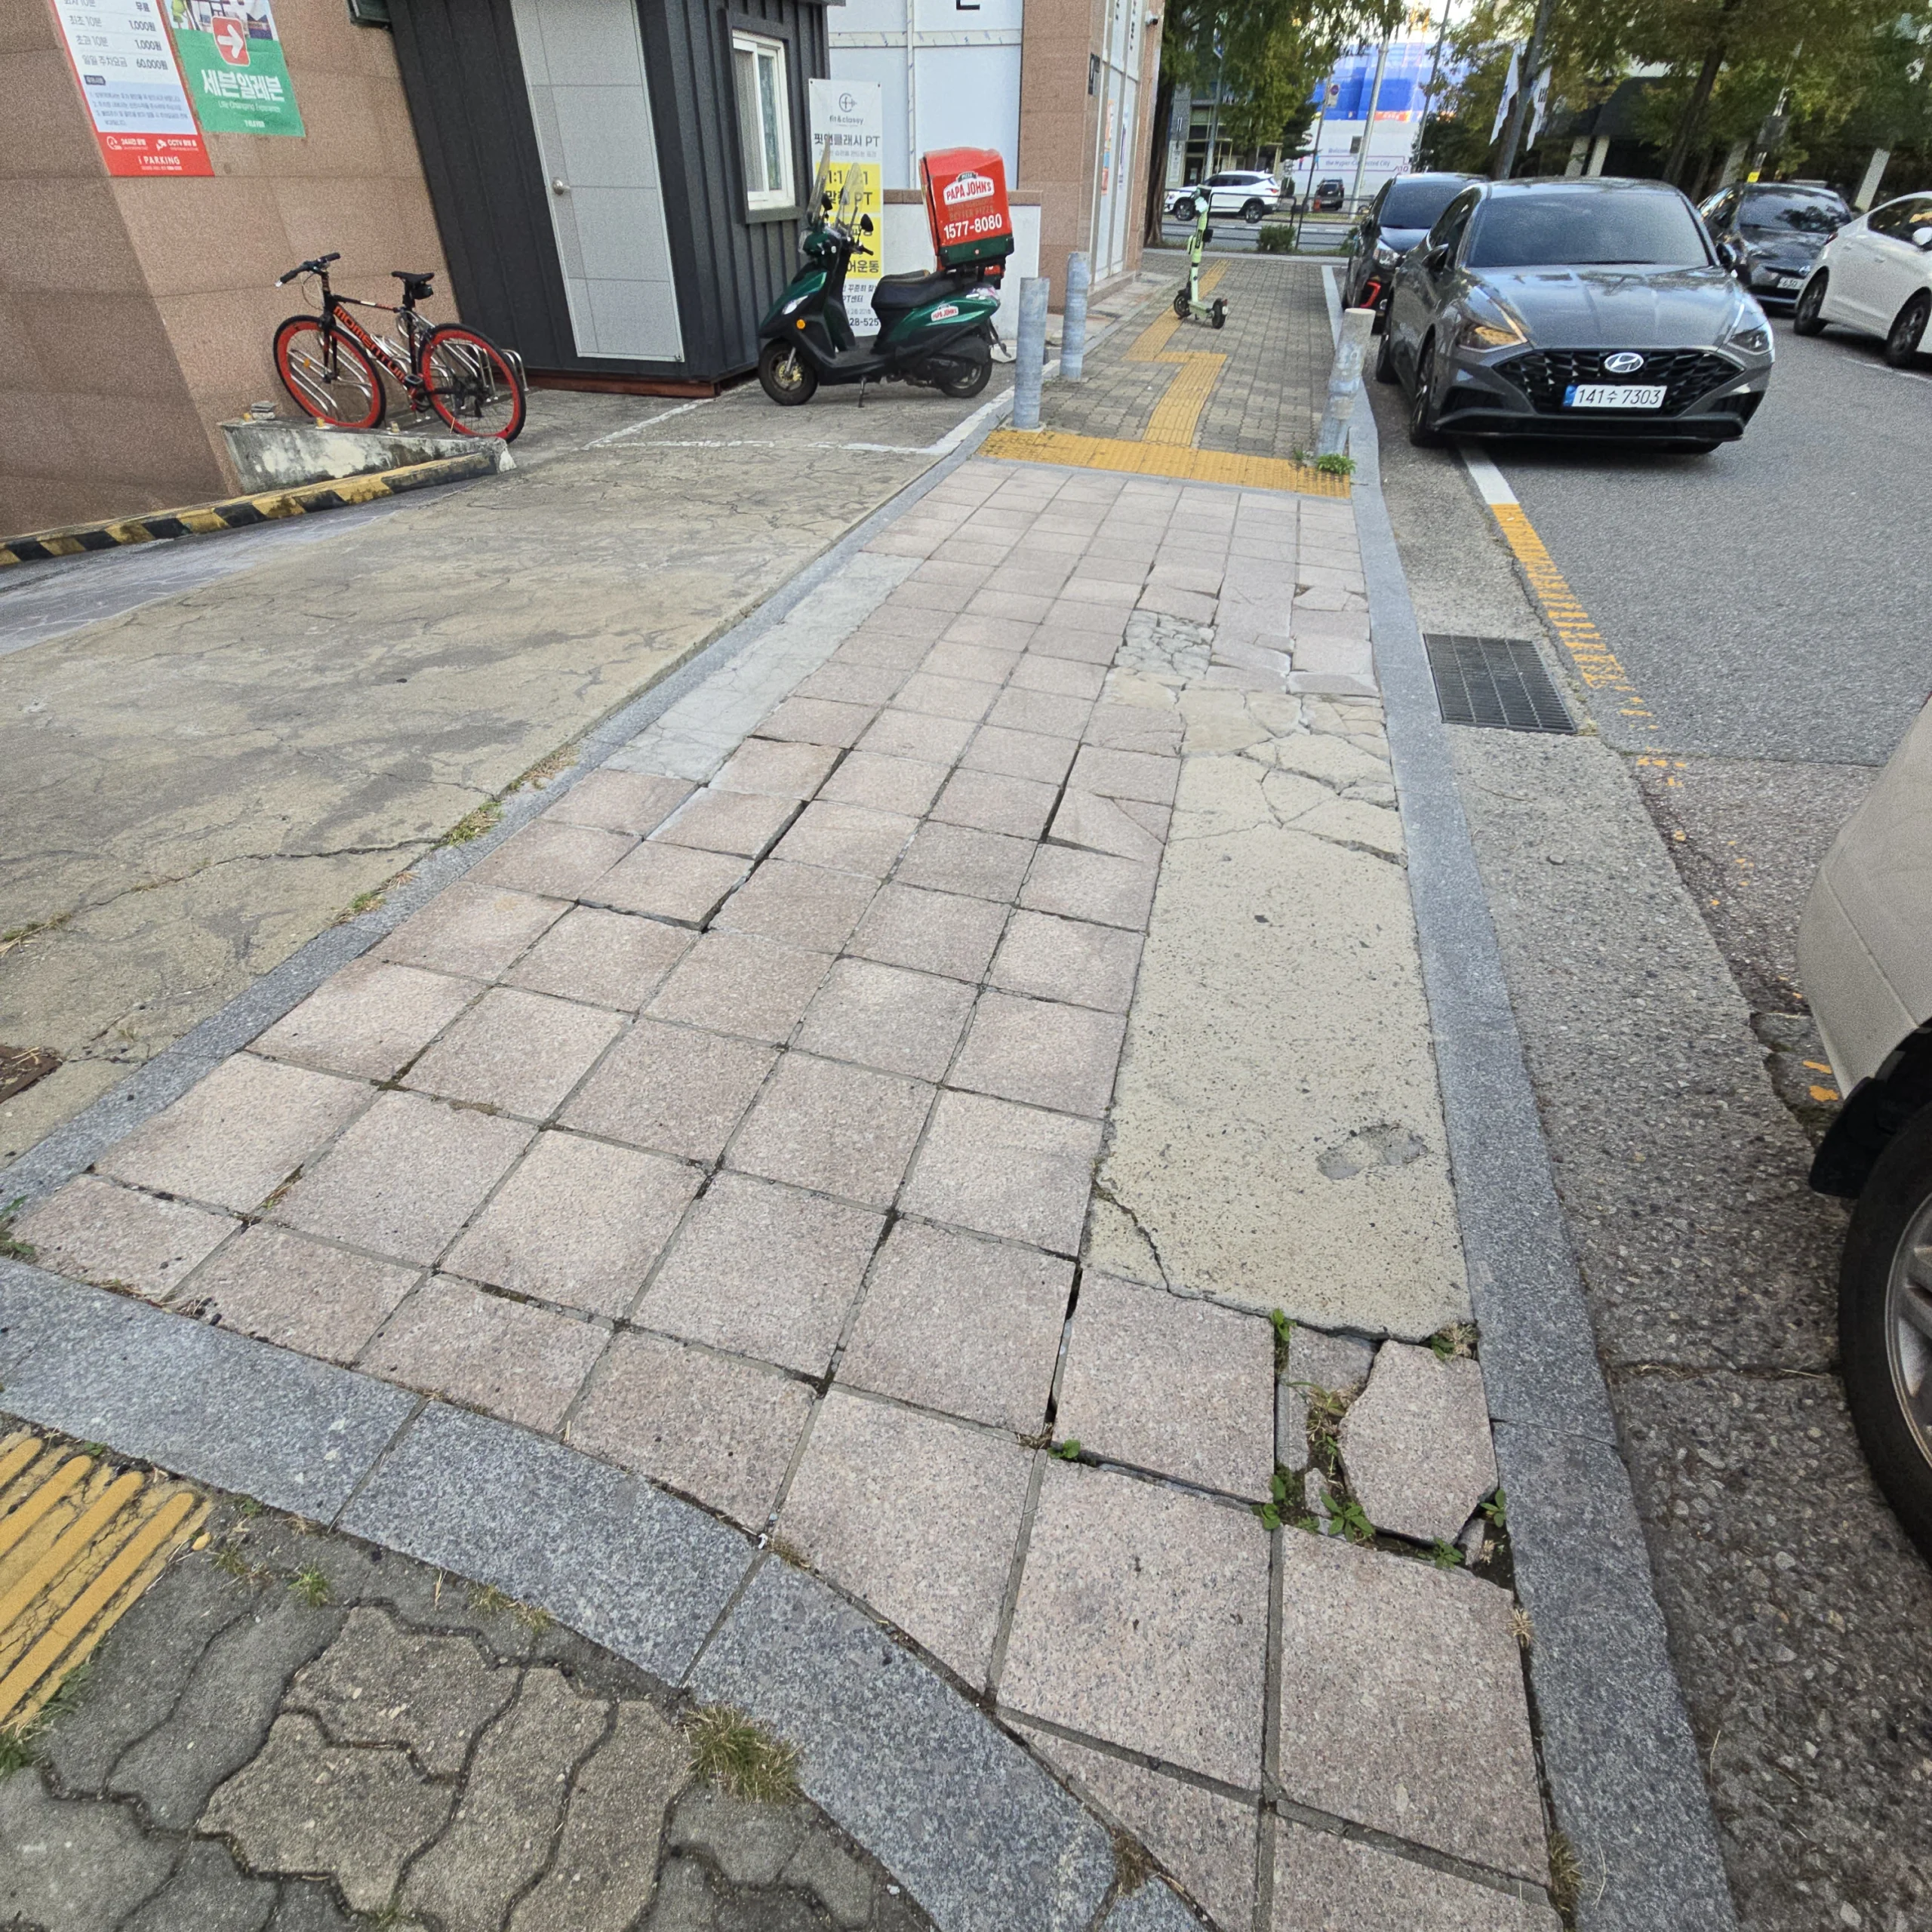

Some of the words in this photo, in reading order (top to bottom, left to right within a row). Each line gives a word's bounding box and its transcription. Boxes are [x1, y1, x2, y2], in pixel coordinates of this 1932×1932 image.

[135, 2, 151, 12] 무료
[69, 15, 85, 26] 최초
[85, 17, 103, 27] 10분
[128, 20, 156, 32] 1,000원
[76, 35, 91, 45] 초과
[92, 35, 109, 47] 10분
[99, 55, 128, 67] 주차요금
[136, 58, 168, 70] 60,000원
[201, 69, 285, 103] 세븐일레븐
[866, 135, 881, 147] PT
[143, 156, 180, 165] PARKING
[946, 184, 966, 201] PAPA
[966, 181, 992, 196] JOHN'S
[943, 213, 1002, 239] 1577-8080
[334, 306, 406, 382] MOMENTUM
[1579, 388, 1617, 404] 141수
[1622, 389, 1662, 405] 7303
